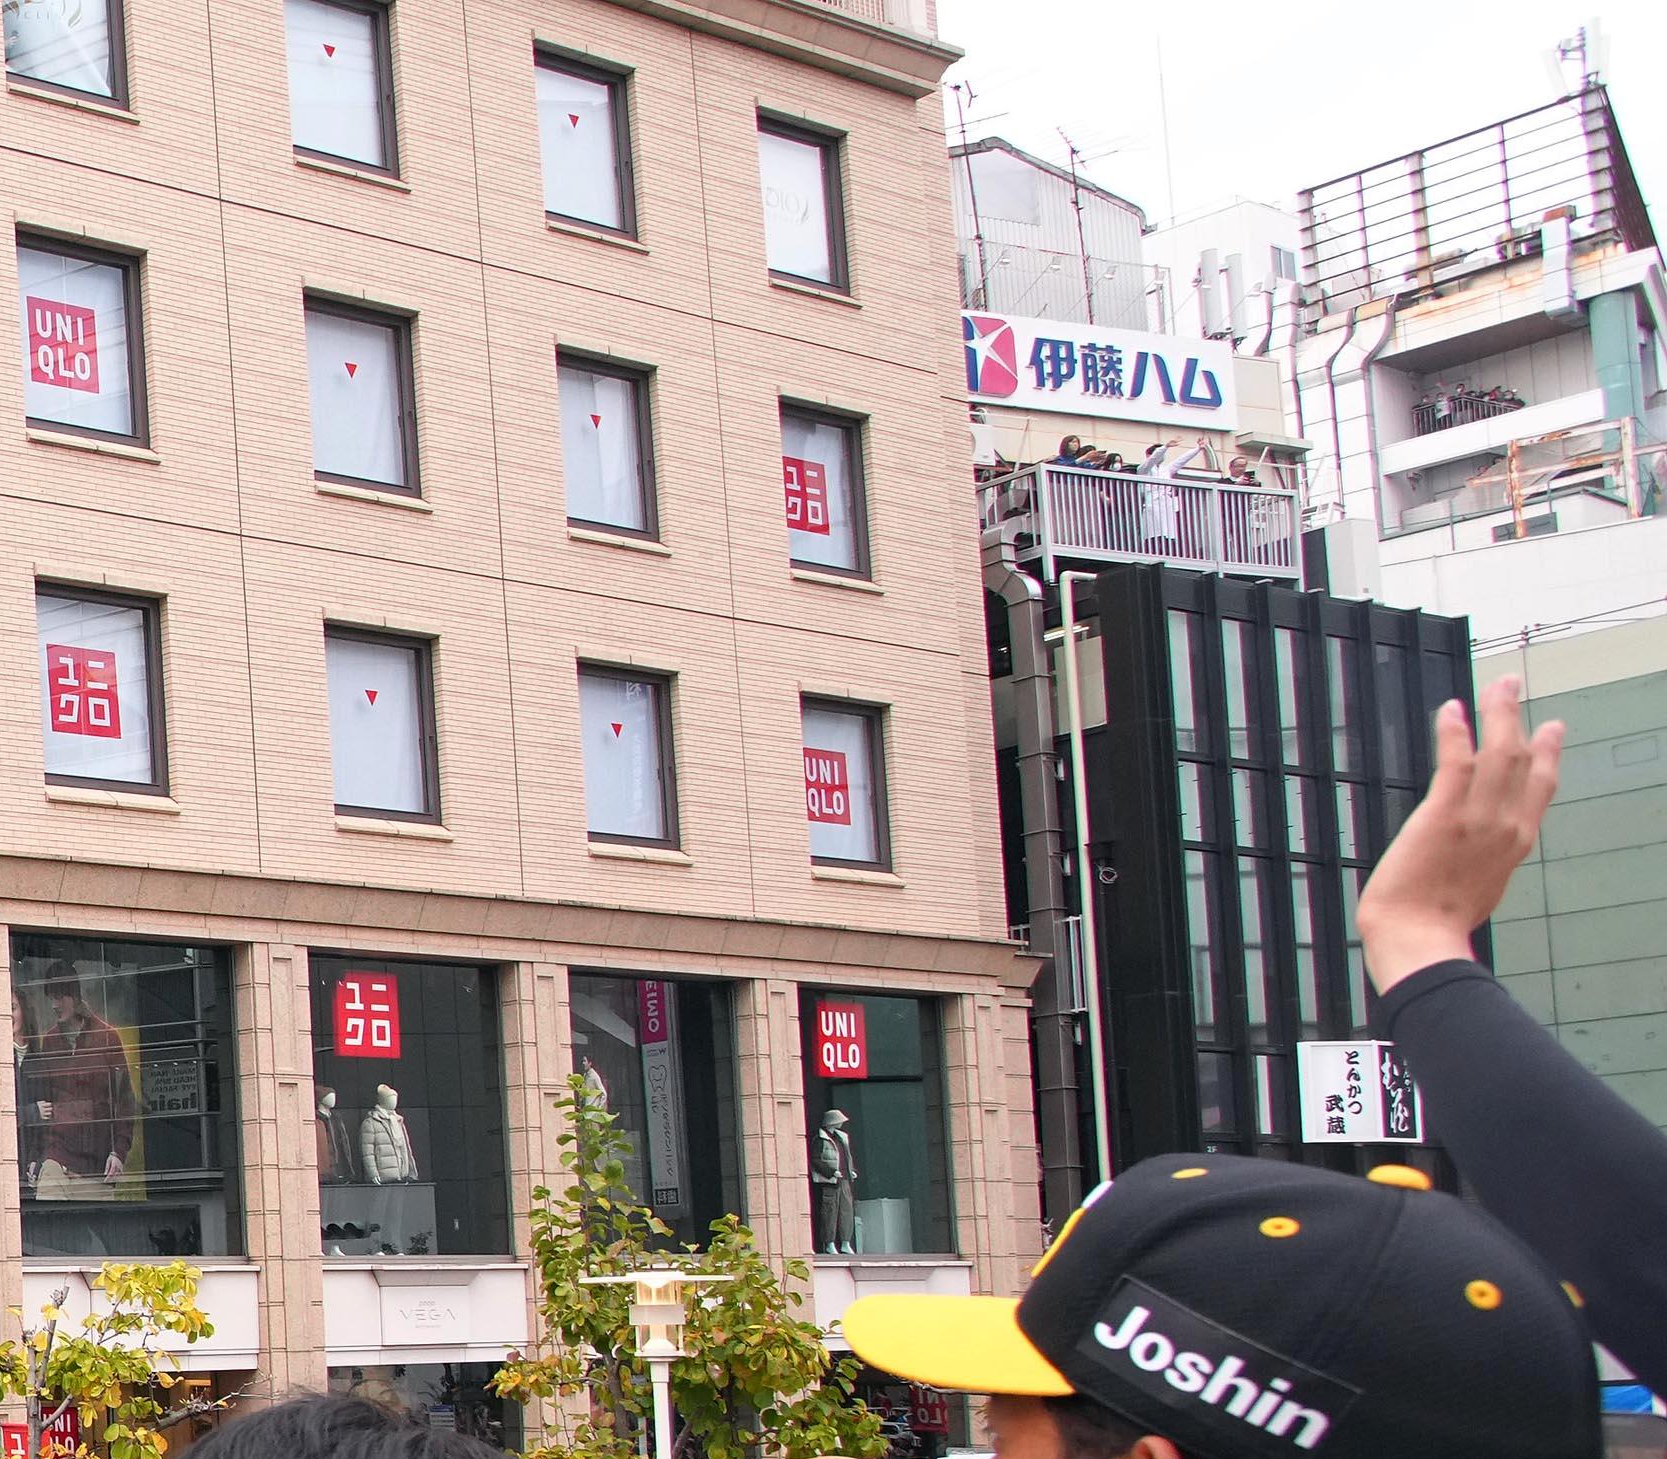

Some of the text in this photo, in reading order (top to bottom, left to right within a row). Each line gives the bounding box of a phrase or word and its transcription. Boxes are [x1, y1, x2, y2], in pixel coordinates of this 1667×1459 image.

[35, 308, 85, 346] UNI
[37, 344, 91, 381] QLO
[1027, 336, 1223, 409] 伊藤ハム
[786, 465, 819, 495] ユニ
[787, 494, 825, 524] クロ
[57, 655, 109, 691] ユニ
[58, 693, 112, 728] クロ
[804, 757, 840, 786] UNI
[806, 787, 845, 818] QLO
[345, 981, 389, 1012] ユニ
[343, 1017, 392, 1048] クロ
[820, 1008, 857, 1038] UNI
[821, 1041, 861, 1070] QLO
[1344, 1050, 1364, 1115] とんかつ
[1324, 1093, 1347, 1135] 武蔵
[1093, 1304, 1335, 1450] Joshin
